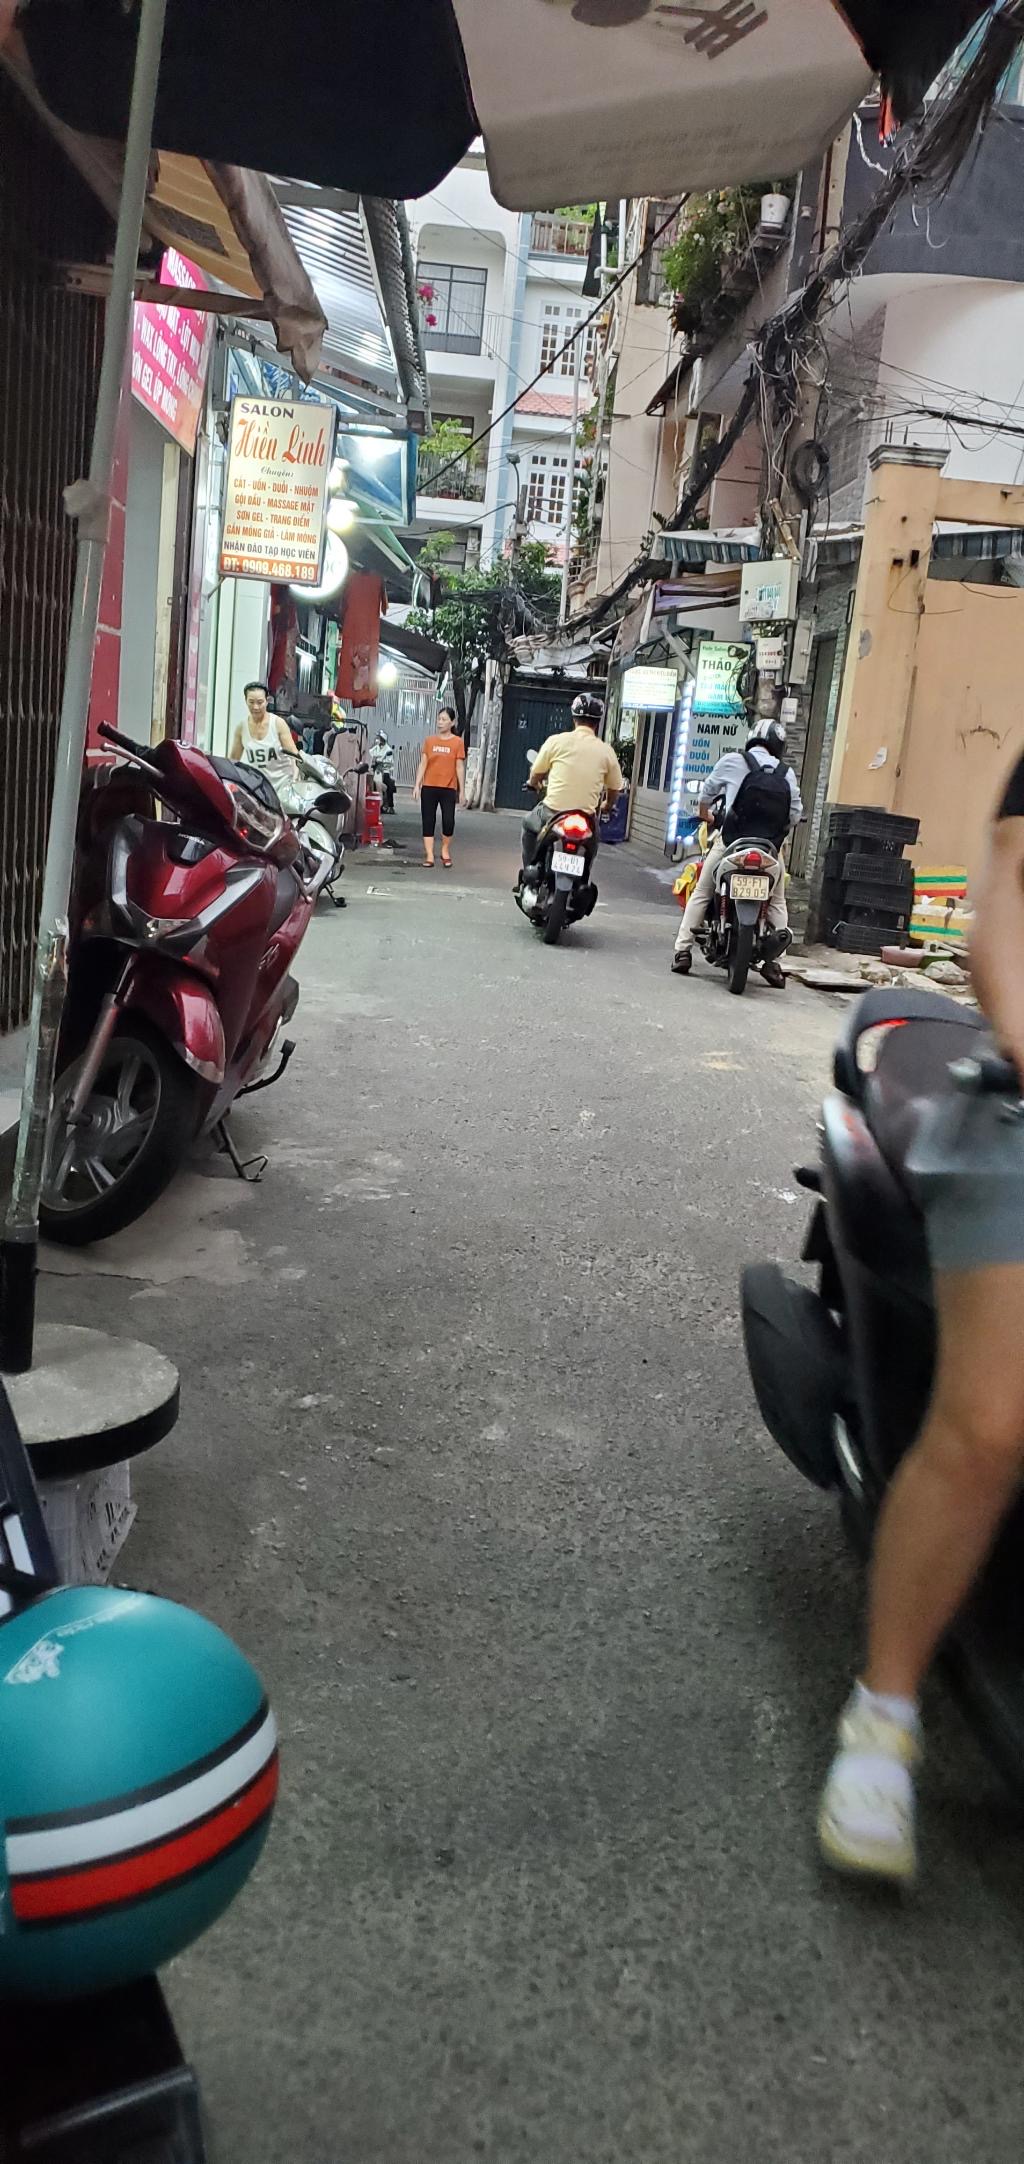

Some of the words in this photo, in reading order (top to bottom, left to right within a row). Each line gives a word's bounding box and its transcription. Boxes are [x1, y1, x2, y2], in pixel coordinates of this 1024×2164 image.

[241, 402, 295, 419] SALON
[235, 418, 278, 460] Hiền
[281, 424, 325, 467] Linh
[267, 498, 298, 511] MASSAGE
[236, 510, 250, 520] SƠN
[252, 512, 264, 522] GEL
[270, 514, 292, 526] TRANG
[242, 524, 262, 538] MÓNG
[296, 532, 317, 544] MÓNG
[224, 540, 245, 553] NHẬN
[246, 542, 262, 554] ĐÀO
[264, 545, 279, 558] TẠO
[280, 548, 296, 560] HỌC
[298, 549, 316, 560] VIÊN
[223, 556, 240, 572] ĐT:
[242, 558, 315, 580] 0909.468.189
[702, 658, 732, 672] THẢO
[697, 723, 720, 735] NAM
[722, 724, 738, 736] NỮ
[246, 747, 278, 764] USA
[736, 877, 762, 888] 59-F1
